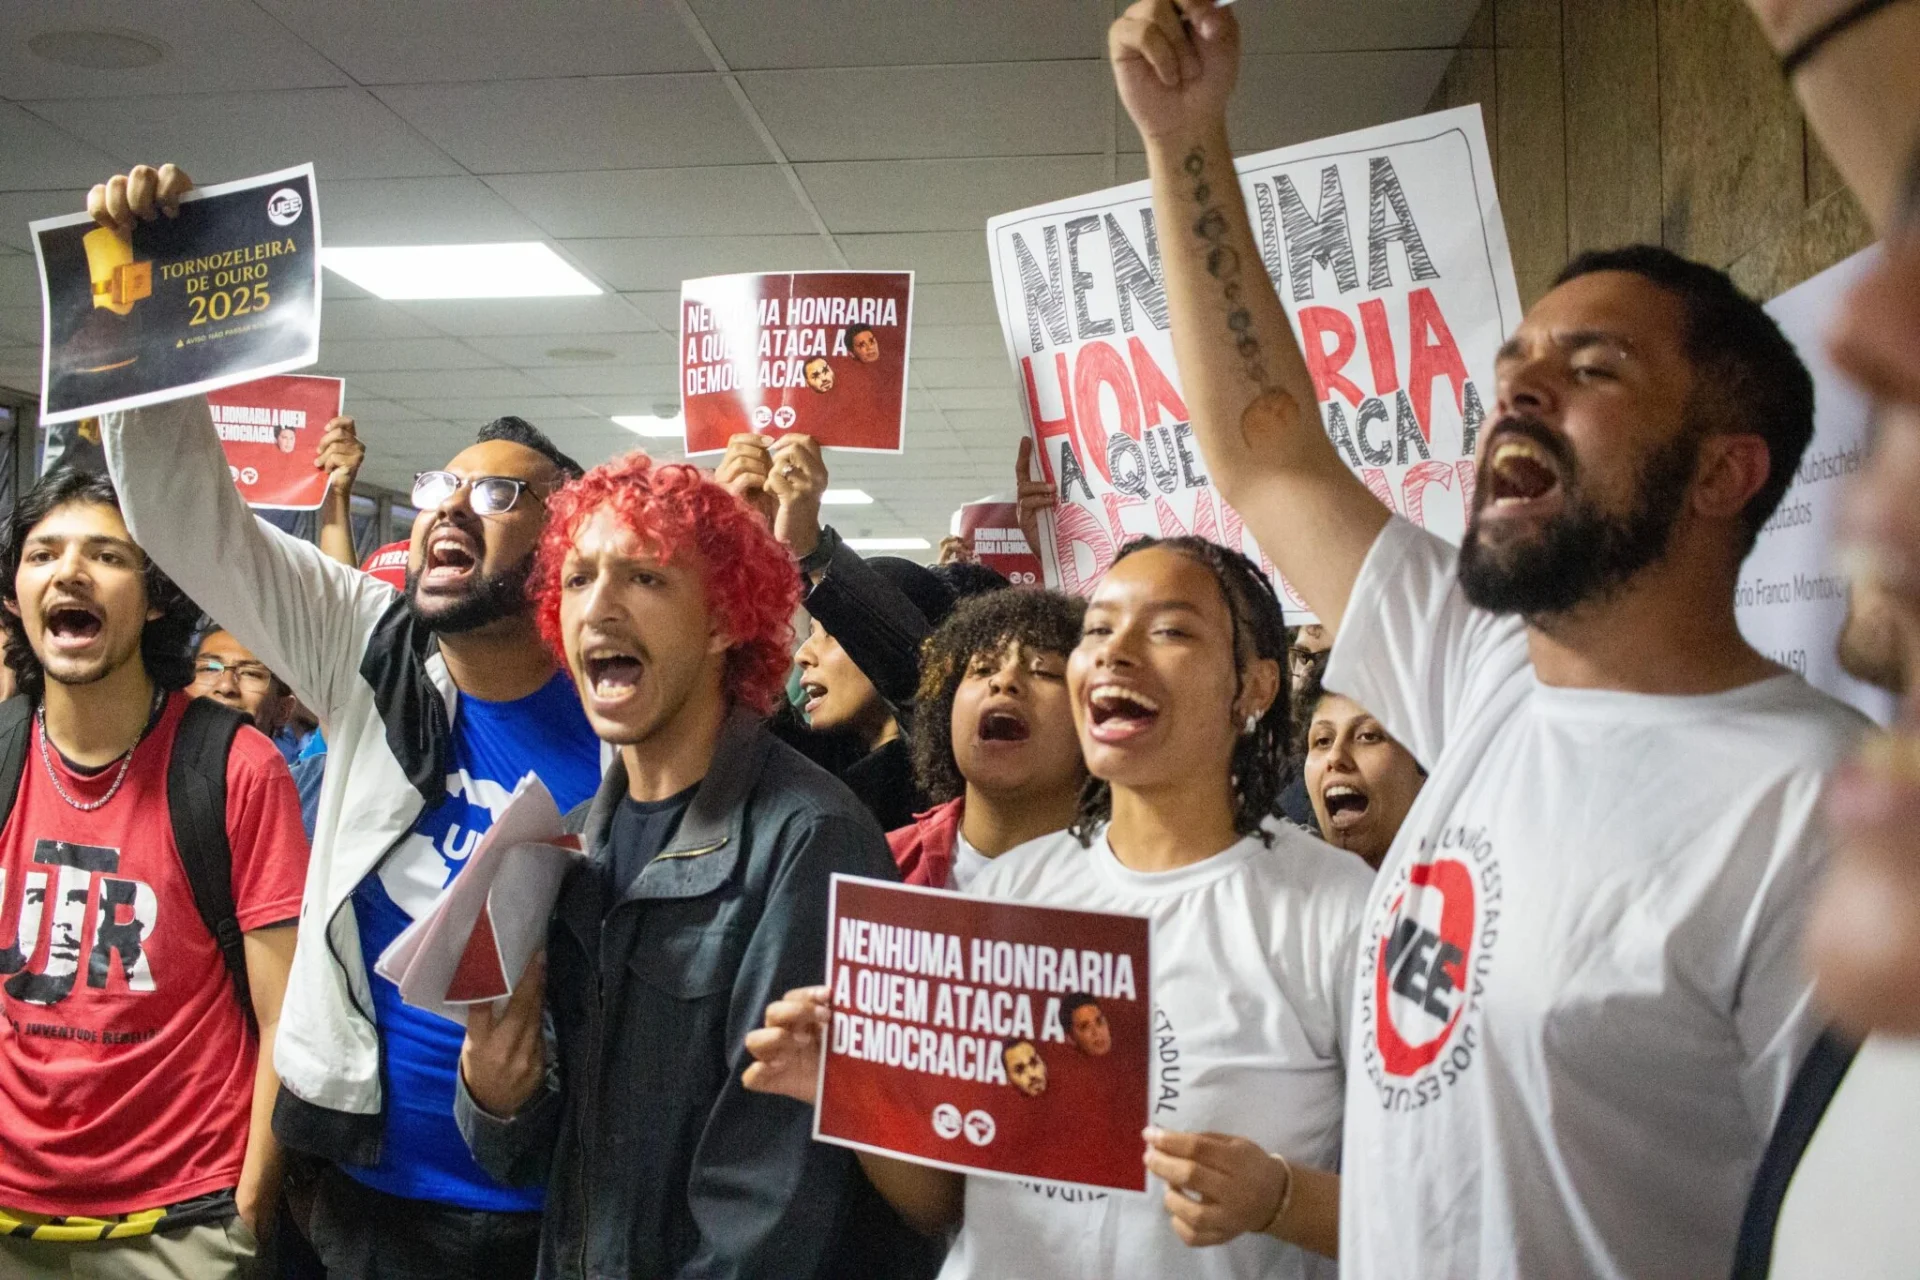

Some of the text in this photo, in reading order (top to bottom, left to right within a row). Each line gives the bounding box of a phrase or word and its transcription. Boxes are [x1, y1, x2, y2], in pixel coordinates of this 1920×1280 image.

[270, 198, 301, 217] UEE
[160, 238, 297, 281] TORNOZELEIRA
[1012, 155, 1441, 354] NENMA
[187, 263, 268, 294] DE OURO
[188, 282, 271, 326] 2025
[687, 297, 898, 334] NEMA HONRARIA
[687, 336, 698, 365] A
[758, 328, 828, 358] ATACA
[832, 328, 848, 358] A
[686, 360, 810, 397] DEMOCACIA
[1021, 287, 1470, 488] HONRIA
[1061, 441, 1095, 503] A
[1106, 421, 1210, 500] QUE
[838, 916, 1137, 1001] NENHUMA HONRARIA
[833, 964, 1066, 1045] A QUEM ATACA A
[25, 1022, 98, 1043] JUVENTUDE
[832, 1011, 1009, 1087] DEMOCRACIA
